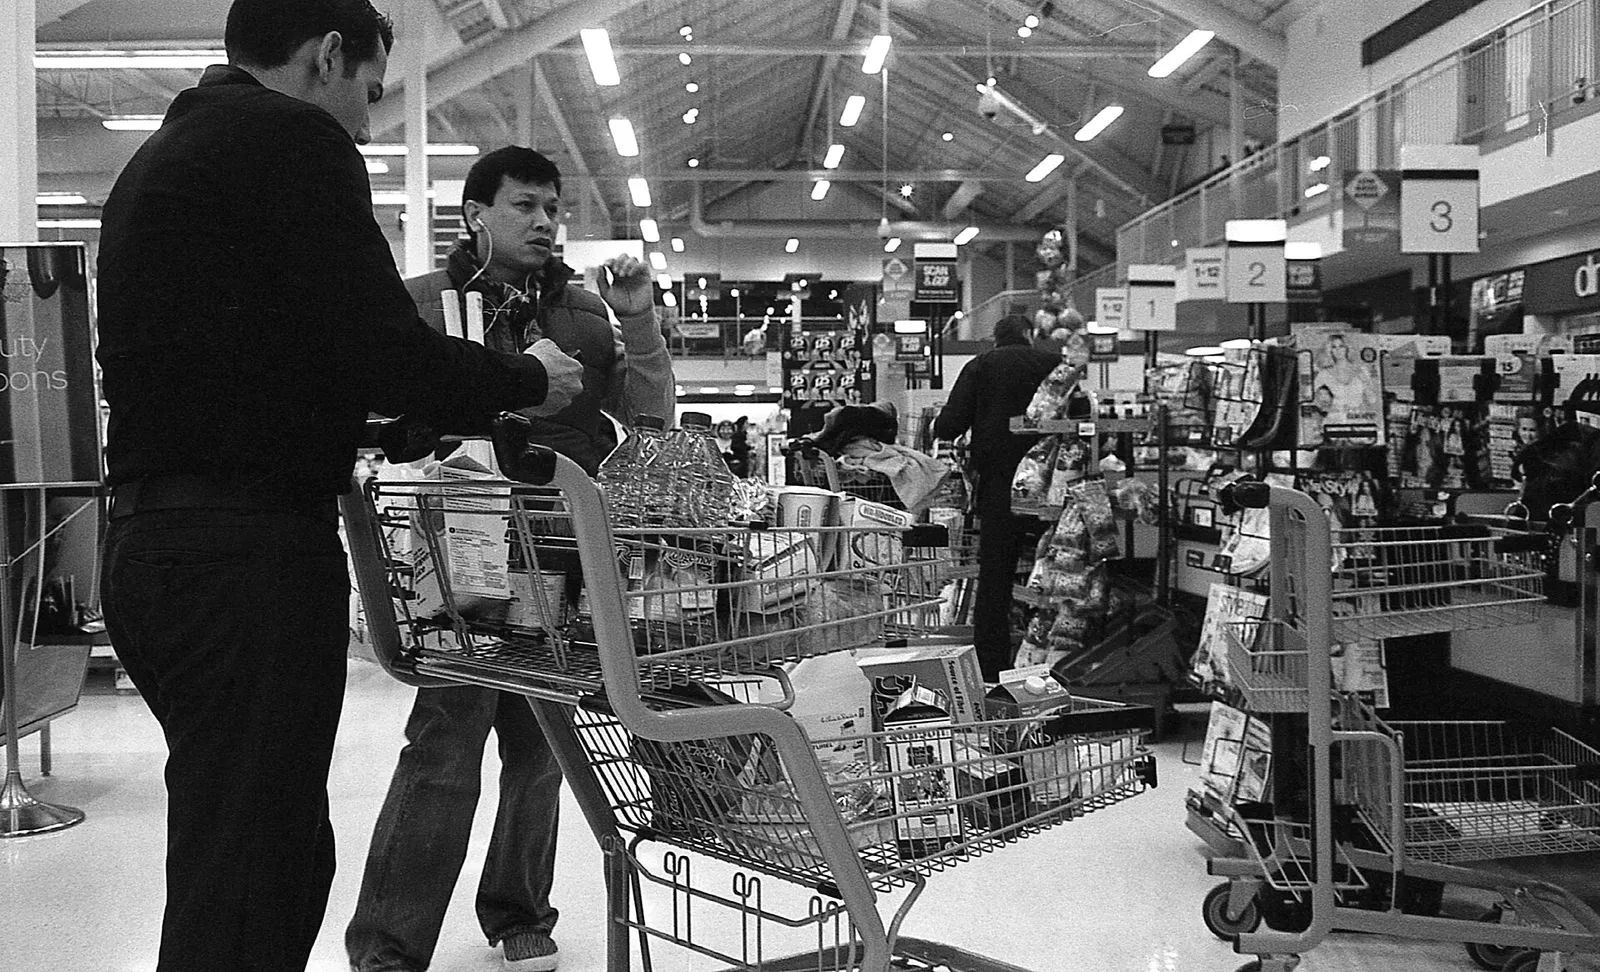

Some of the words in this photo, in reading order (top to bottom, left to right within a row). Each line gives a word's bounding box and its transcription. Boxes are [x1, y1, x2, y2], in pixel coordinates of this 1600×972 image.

[1430, 200, 1453, 233] 3
[1248, 261, 1267, 287] 2
[1148, 300, 1155, 318] 1
